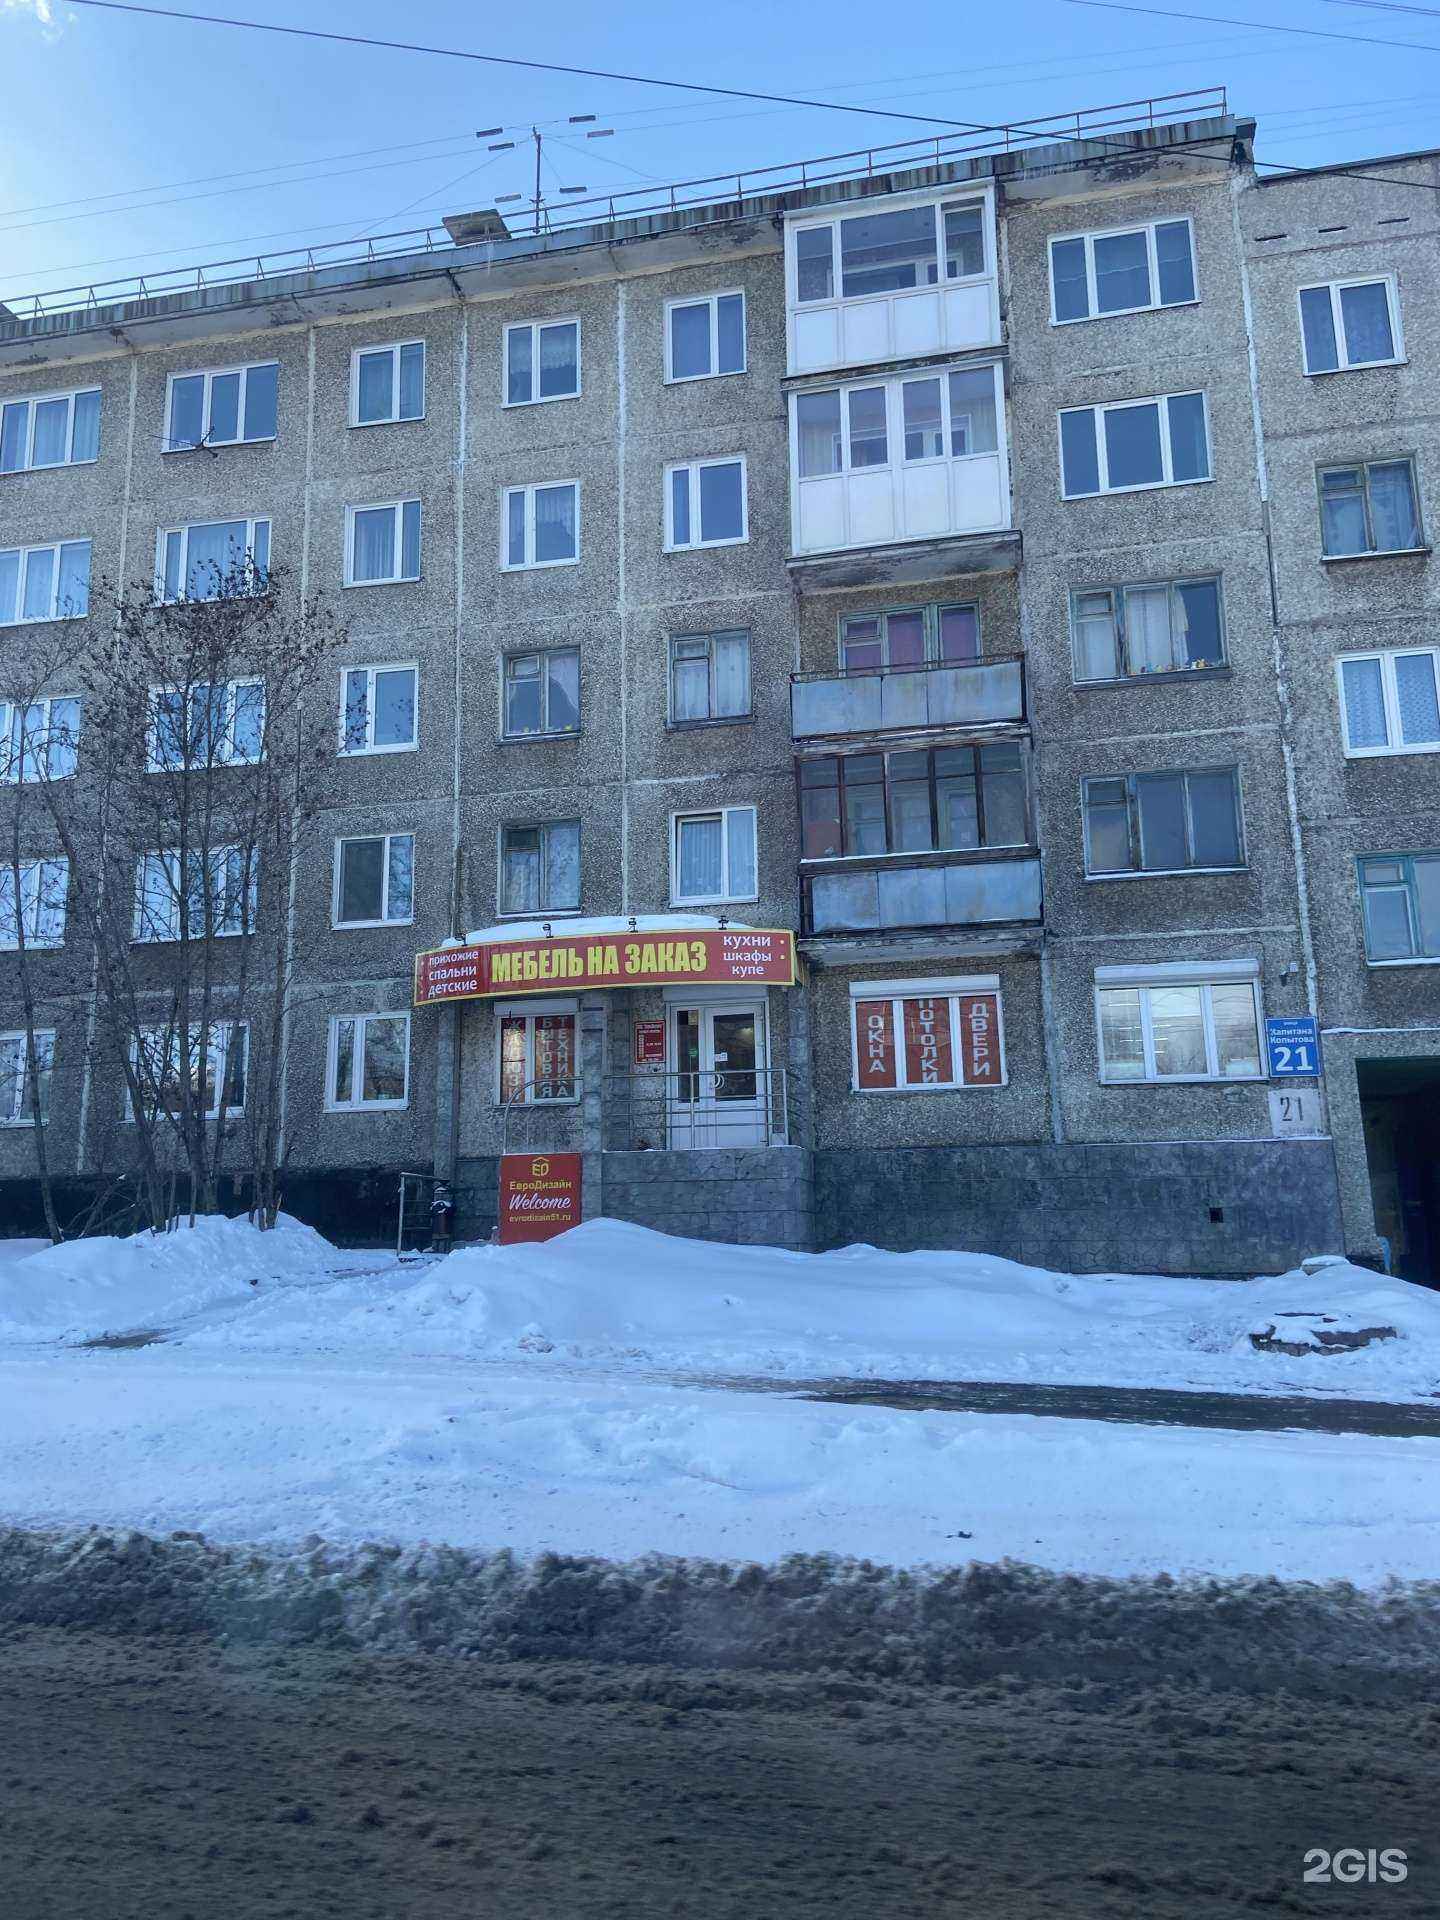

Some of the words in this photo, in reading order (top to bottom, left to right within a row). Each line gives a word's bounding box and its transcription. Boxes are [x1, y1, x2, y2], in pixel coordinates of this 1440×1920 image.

[723, 935, 771, 949] кухни
[429, 951, 479, 967] прихожие
[491, 947, 584, 983] МЕБЕЛЬ
[587, 945, 620, 976] НА
[624, 941, 707, 974] ЗАКАЗ
[723, 949, 772, 964] шкафы
[428, 966, 477, 981] спальни
[732, 965, 765, 978] купе
[428, 980, 477, 998] детские
[968, 1002, 991, 1077] ДВЕРИ
[1270, 1028, 1313, 1036] Капитана
[1270, 1036, 1315, 1044] Копытова
[867, 1014, 887, 1074] ОКНА
[918, 999, 939, 1084] ПОТОЛКИ
[1274, 1046, 1314, 1072] 21
[1280, 1096, 1304, 1121] 21
[509, 1180, 572, 1191] ЕвроДизайн
[509, 1192, 572, 1211] Welcome
